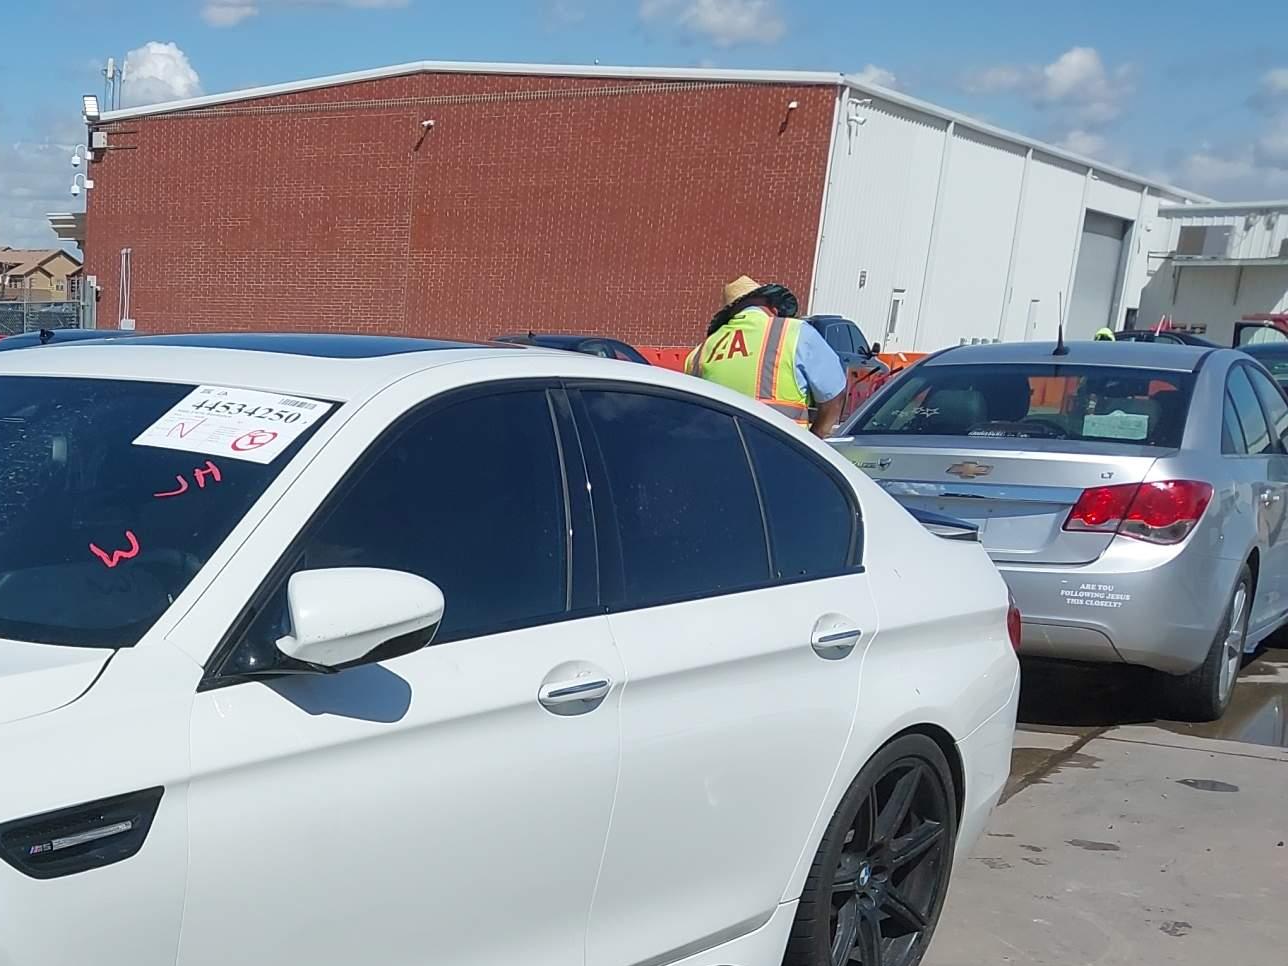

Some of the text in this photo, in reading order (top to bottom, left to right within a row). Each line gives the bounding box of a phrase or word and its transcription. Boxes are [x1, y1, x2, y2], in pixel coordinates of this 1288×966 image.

[192, 399, 301, 424] 44534250
[1100, 471, 1114, 479] LT
[1097, 584, 1114, 592] YOU
[1060, 590, 1131, 601] FOLLOWING JESUS
[1085, 599, 1122, 607] CLOSELY?
